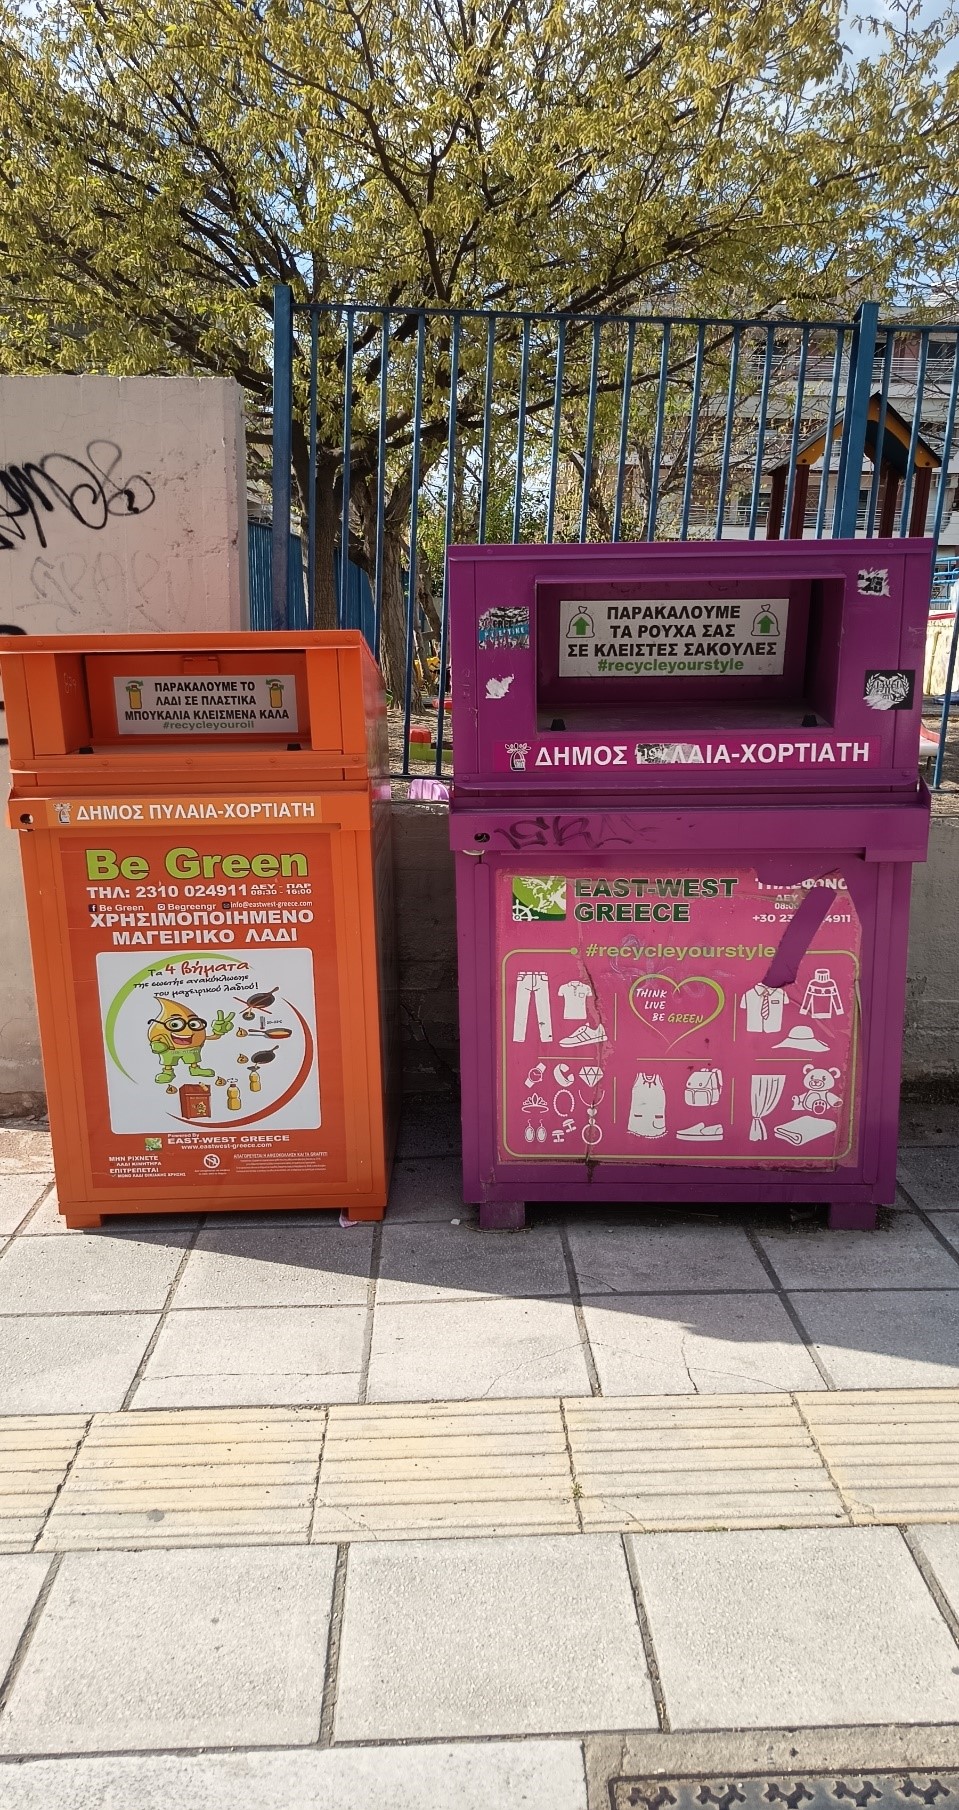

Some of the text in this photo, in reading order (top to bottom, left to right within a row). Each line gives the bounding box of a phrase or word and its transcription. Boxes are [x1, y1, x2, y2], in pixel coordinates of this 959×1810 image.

[606, 606, 740, 620] ΠΑΡΑΚΑΛΟΥΜΕ
[610, 624, 736, 638] ΤΑ ΡΟΥΧΑ ΣΑΣ
[568, 642, 777, 657] ΣΕ ΚΛΕΙΣΤΕΣ ΣΑΚΟΥΛΕΣ
[598, 658, 744, 674] #recycleyourstyle
[154, 682, 256, 692] ΠΑΡΑΚΑΛΟΥΜΕ ΤΟ
[156, 696, 256, 706] ΛΑΔΙ ΣΕ ΠΛΑΣΤΙΚΑ
[125, 710, 289, 720] ΜΠΟΥΚΑΛΙΑ ΚΛΕΙΣΜΕΝΑ ΚΑΛΑ
[163, 721, 254, 731] #recycleyouroil
[535, 743, 870, 766] ΔΗΜΟΣ ΛΑΙΑ-ΧΟΡΤΙΑΤΗ
[76, 802, 314, 820] ΔΗΜΟΣ ΠΥΛΑΙΑ-ΧΟΡΤΙΑΤΗ
[85, 847, 308, 880] Be Green
[86, 884, 247, 899] ΤΗΛ: 2310 024911
[574, 878, 739, 898] EAST-WEST
[168, 903, 216, 912] Begreengr
[574, 902, 690, 923] GREECE
[90, 909, 314, 927] ΧΡΗΣΙΜΟΠΟΙΗΜΕΝΟ
[752, 914, 776, 922] +30
[112, 928, 298, 945] ΜΑΓΕΙΡΙΚΟ ΛΑΔΙ
[586, 943, 776, 961] #recycleyourstyle
[148, 961, 249, 977] Τα 4 βήματα
[636, 988, 668, 998] THINK
[644, 1001, 666, 1010] LIVE
[652, 1013, 704, 1023] BE GREEN
